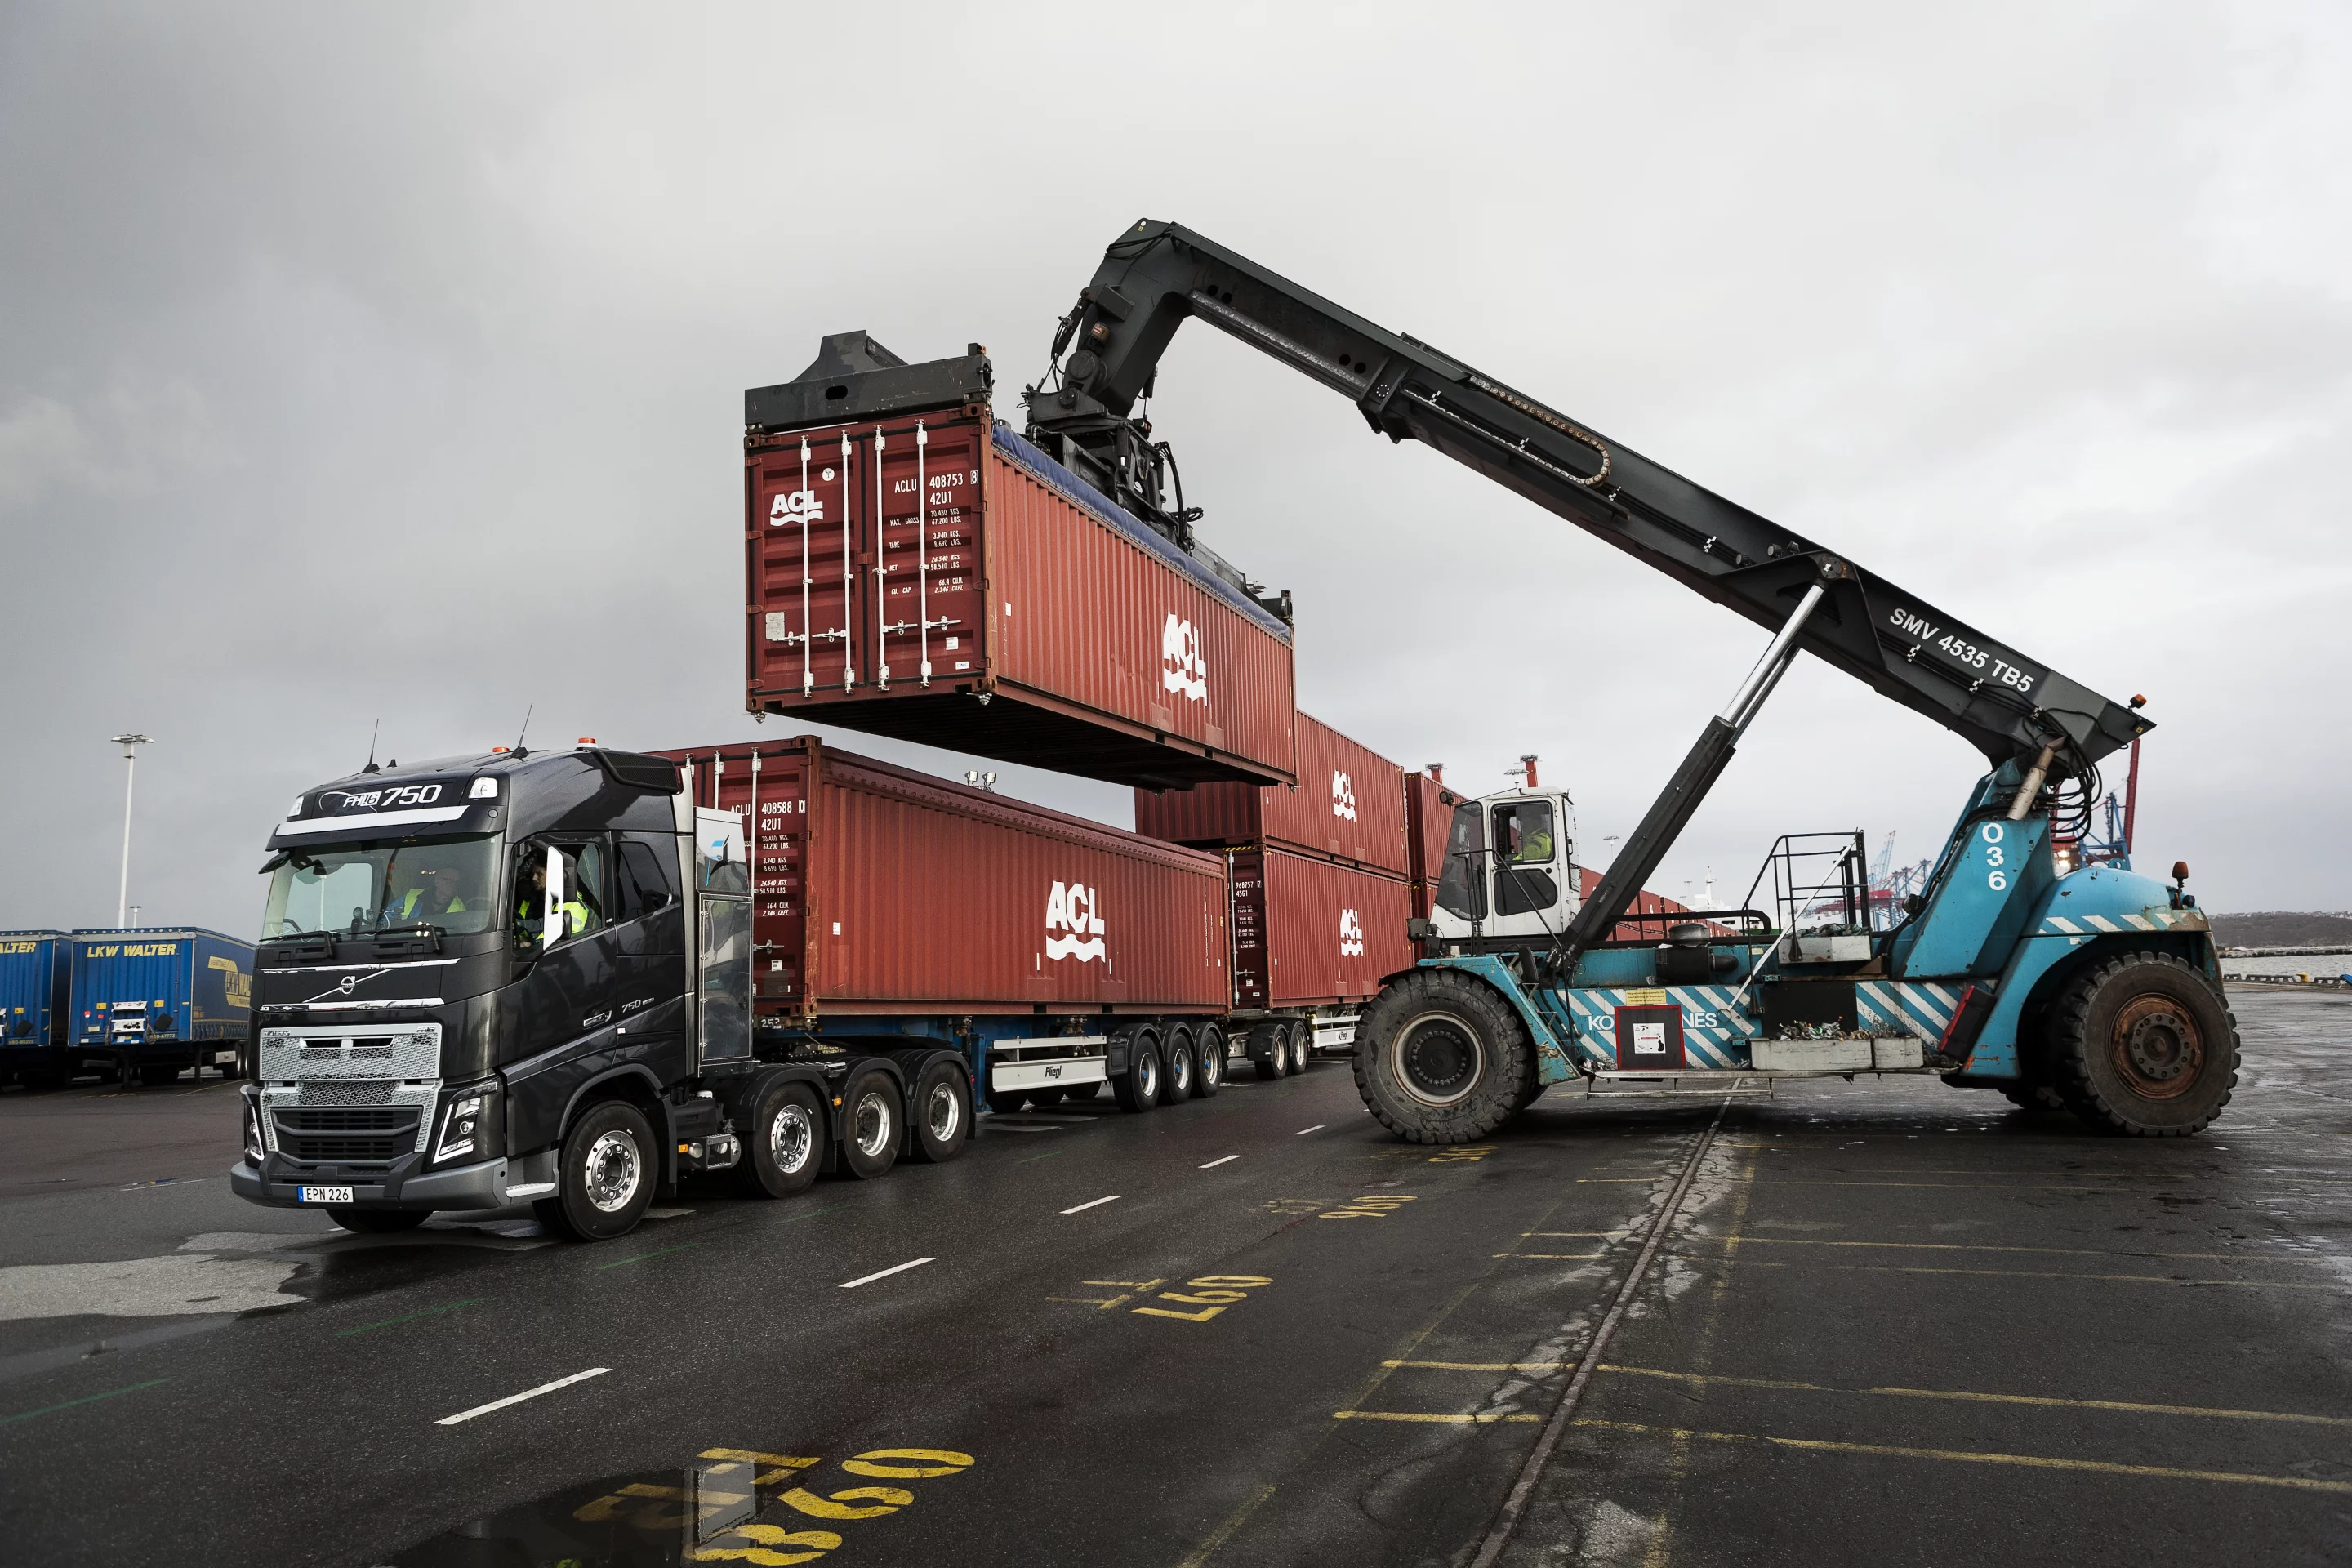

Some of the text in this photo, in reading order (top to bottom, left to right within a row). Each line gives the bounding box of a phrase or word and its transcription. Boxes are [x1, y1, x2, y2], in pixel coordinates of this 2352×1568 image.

[894, 470, 978, 493] ACLU 408753 8
[771, 490, 823, 514] ACL
[930, 491, 951, 505] 42U1
[930, 509, 947, 517] 30.480
[905, 517, 920, 525] GROSS
[932, 517, 948, 525] 67.200
[934, 540, 947, 548] 8.690
[931, 563, 947, 571] 58.510
[938, 578, 950, 586] 66.4
[1164, 611, 1206, 678] ACL
[1890, 608, 2034, 693] SMV 4535 TB5
[1333, 770, 1355, 804] ACL
[381, 785, 443, 806] 750
[761, 801, 792, 815] 408588
[799, 800, 805, 813] 0
[761, 818, 781, 831] 42U1
[1046, 880, 1105, 936] ACL
[1340, 909, 1362, 941] ACL
[87, 944, 176, 958] LKW WALTER
[622, 1000, 641, 1013] 750
[1045, 1065, 1062, 1079] Fliegl
[306, 1188, 325, 1200] EPN
[329, 1188, 349, 1200] 226
[1130, 1275, 1274, 1321] 097
[684, 1448, 976, 1566] 098
